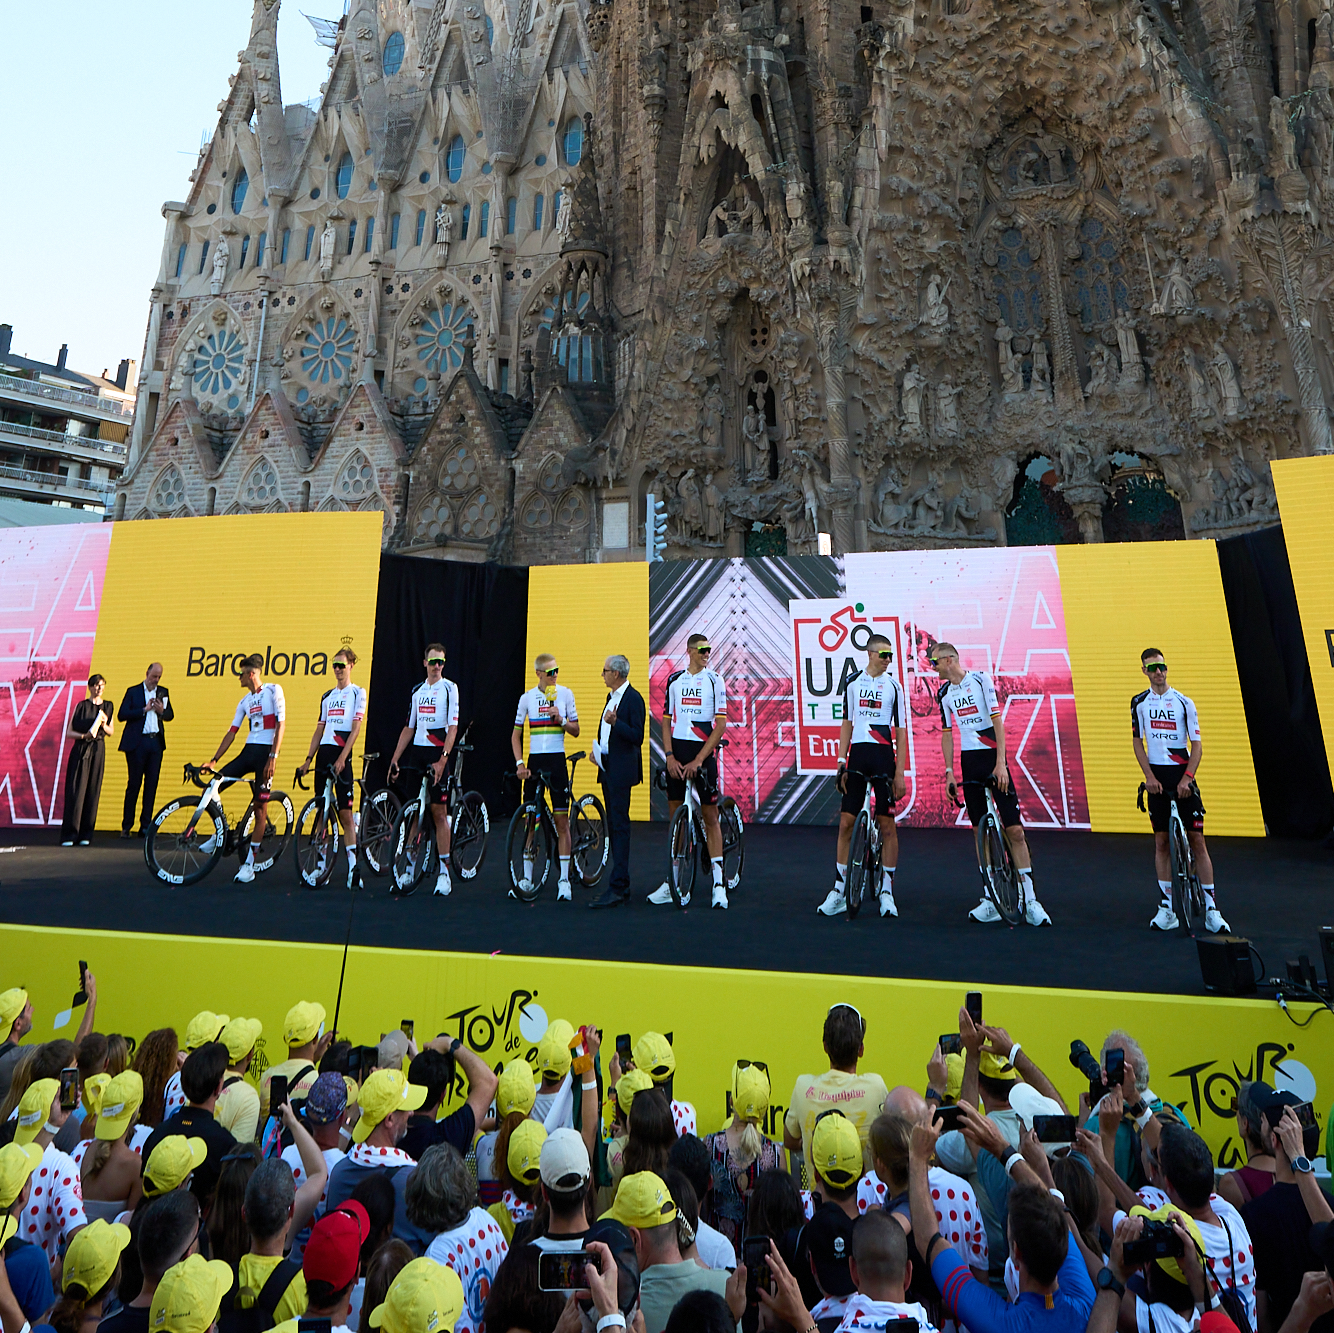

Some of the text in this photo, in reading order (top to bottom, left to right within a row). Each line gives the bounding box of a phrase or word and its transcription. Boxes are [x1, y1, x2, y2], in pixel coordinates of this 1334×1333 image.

[681, 688, 702, 697] UAE
[860, 689, 882, 700] UAE
[329, 701, 346, 709] UAE
[419, 697, 436, 705] UAE
[954, 695, 975, 708] UAE
[1149, 710, 1175, 720] UAE
[1151, 732, 1178, 741] XRG
[445, 989, 538, 1052] TOUR
[505, 1031, 521, 1052] de
